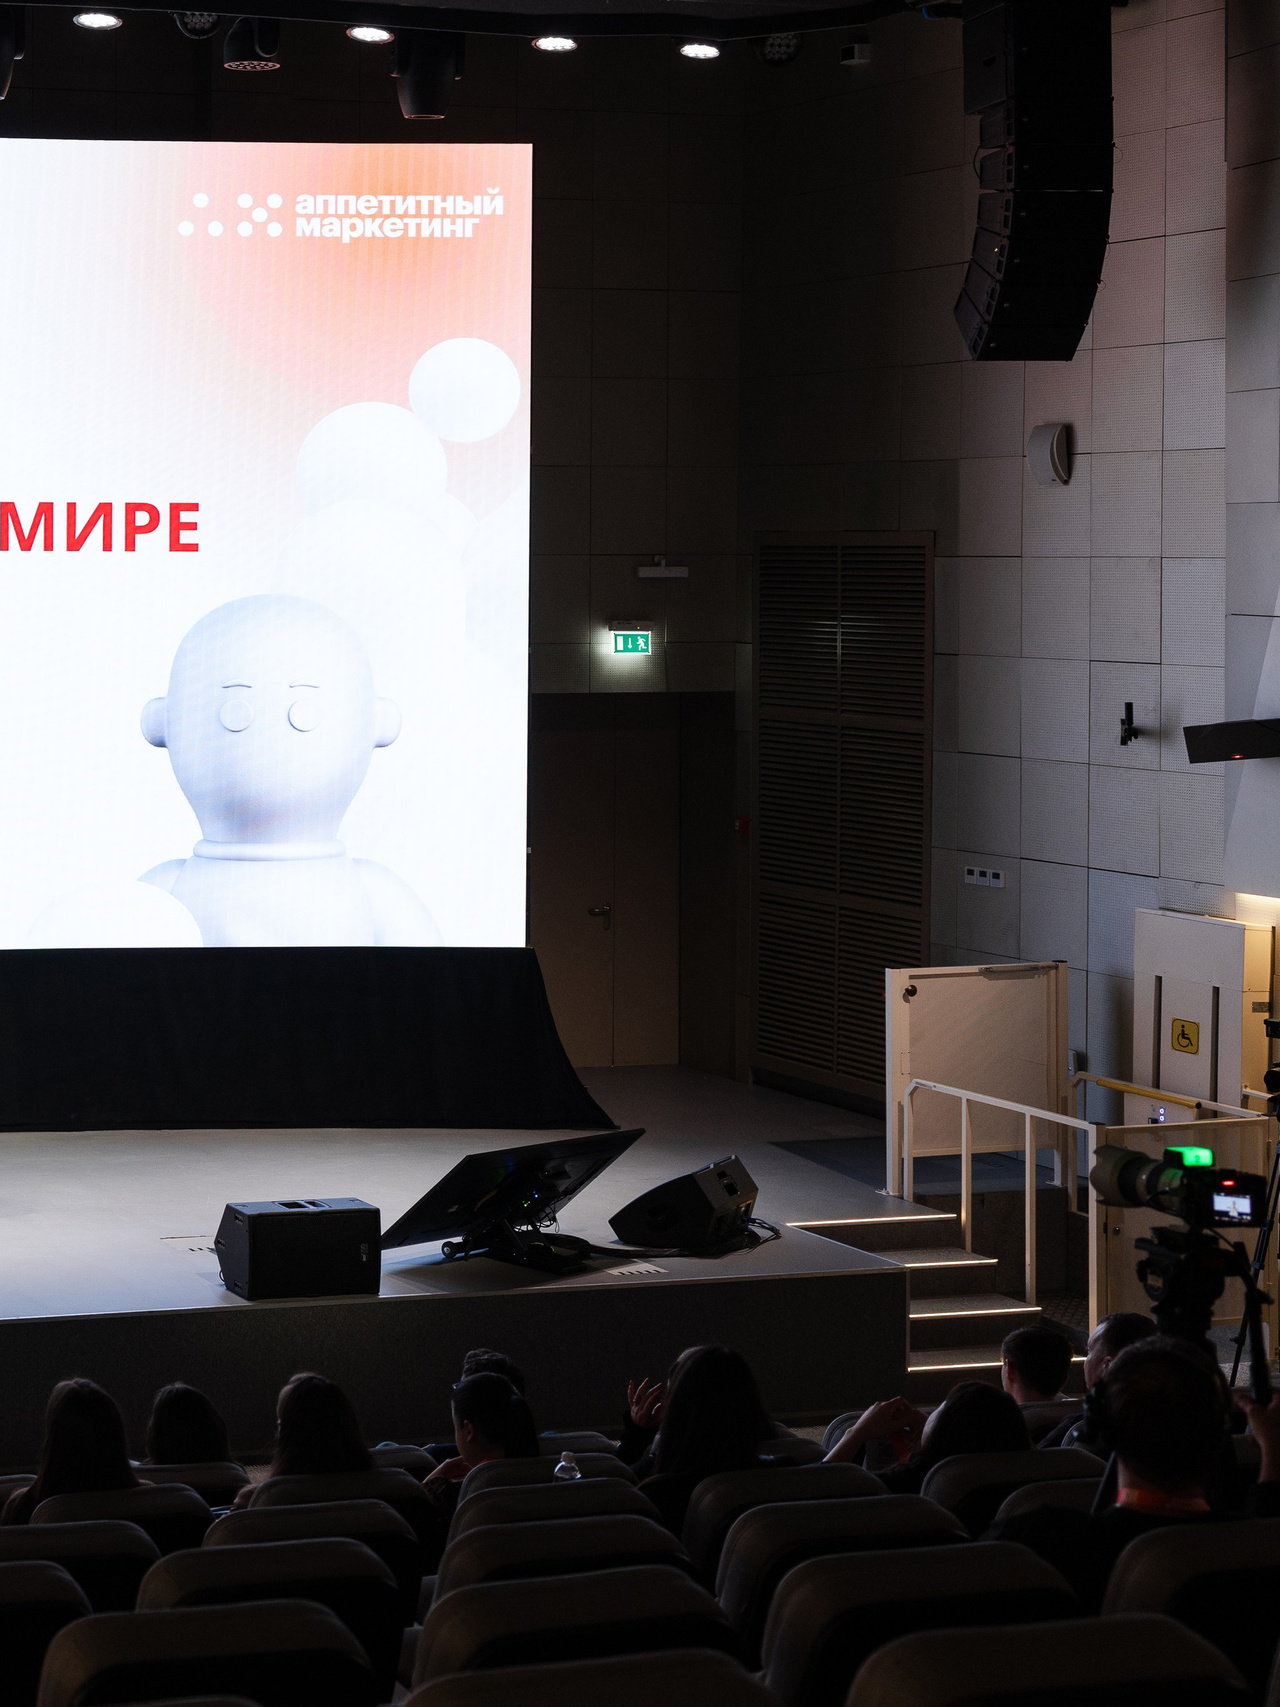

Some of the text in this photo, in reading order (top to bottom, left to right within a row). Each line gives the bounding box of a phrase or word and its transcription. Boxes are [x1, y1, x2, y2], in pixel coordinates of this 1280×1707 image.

[295, 187, 504, 215] аппетитный
[295, 216, 480, 243] маркетинг
[0, 502, 200, 553] МИРЕ
